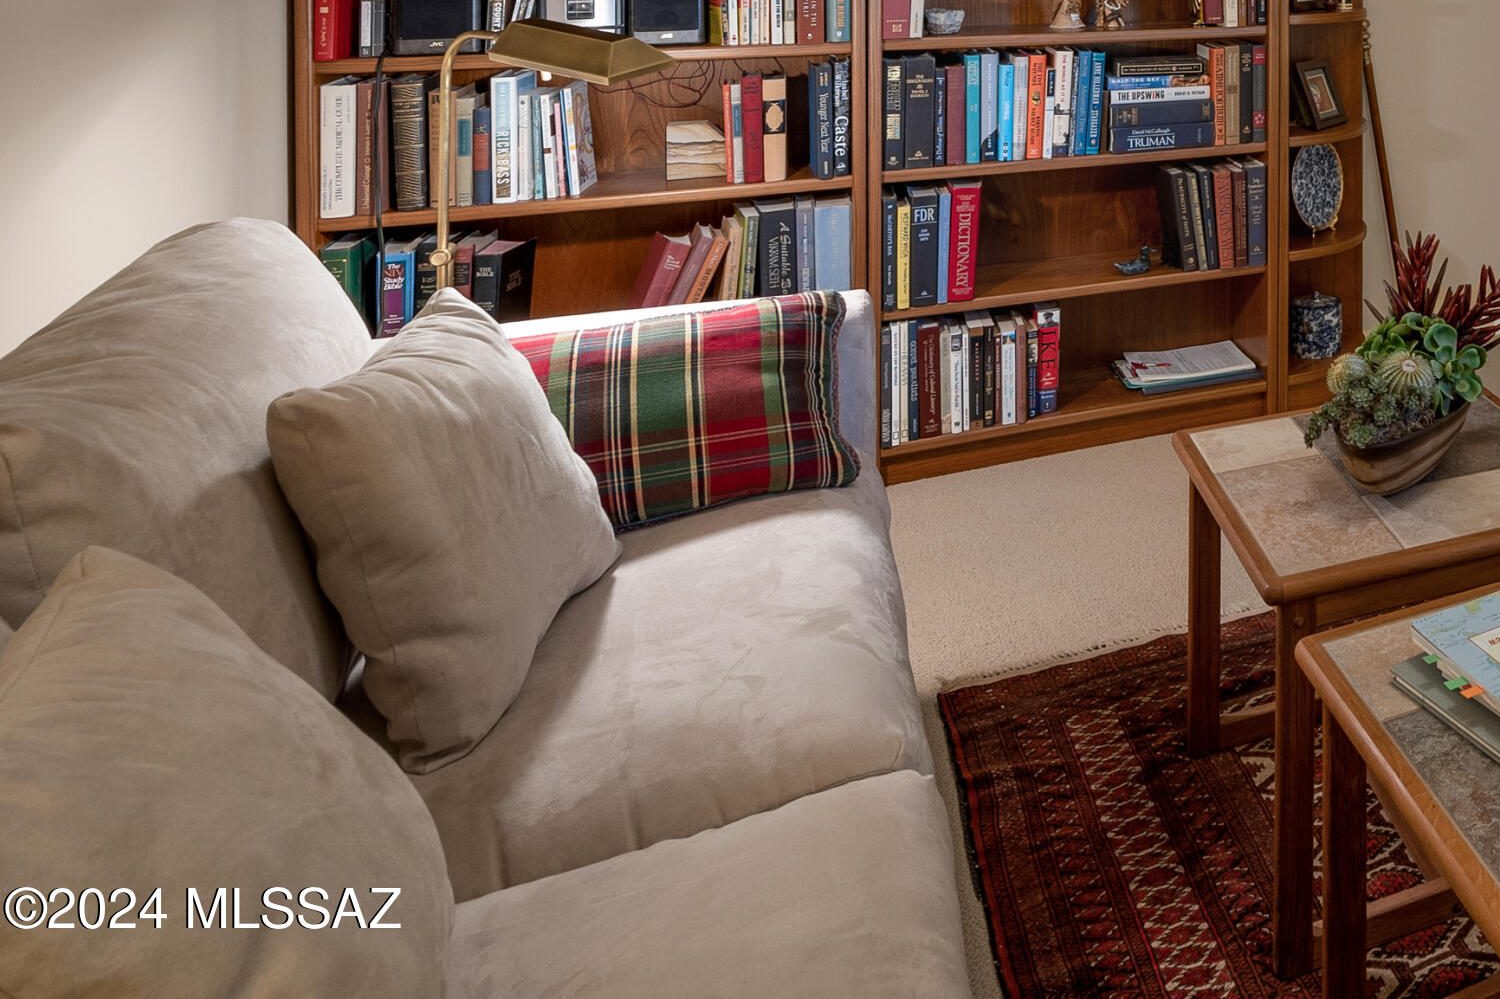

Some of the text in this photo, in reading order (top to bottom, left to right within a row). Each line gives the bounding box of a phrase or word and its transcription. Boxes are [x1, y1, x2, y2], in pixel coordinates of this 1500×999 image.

[811, 0, 817, 8] IN
[887, 65, 901, 80] KEN
[1215, 73, 1224, 89] TIME
[834, 74, 842, 107] Wilkerson
[841, 79, 849, 101] Isabel
[886, 81, 901, 112] FOLLETT
[1089, 62, 1102, 138] ANNE HILLERMAN STARGAZER
[1118, 91, 1165, 101] THE UPSWING
[1216, 90, 1225, 103] FOR
[817, 93, 830, 153] Younger Next Year
[1216, 104, 1225, 125] TRUTH
[335, 118, 343, 150] MEDICAL
[834, 115, 849, 157] Caste
[1127, 136, 1176, 148] TRUMAN
[496, 130, 510, 184] RICK BASS
[1178, 185, 1187, 215] AUDACITY
[914, 208, 934, 223] FDR
[767, 236, 780, 289] VIKRAM SETH
[780, 221, 793, 297] A Suitable Bo
[902, 241, 910, 258] WHOA
[955, 213, 972, 288] DICTIONARY
[384, 269, 404, 277] NIV
[1041, 331, 1056, 370] IKE
